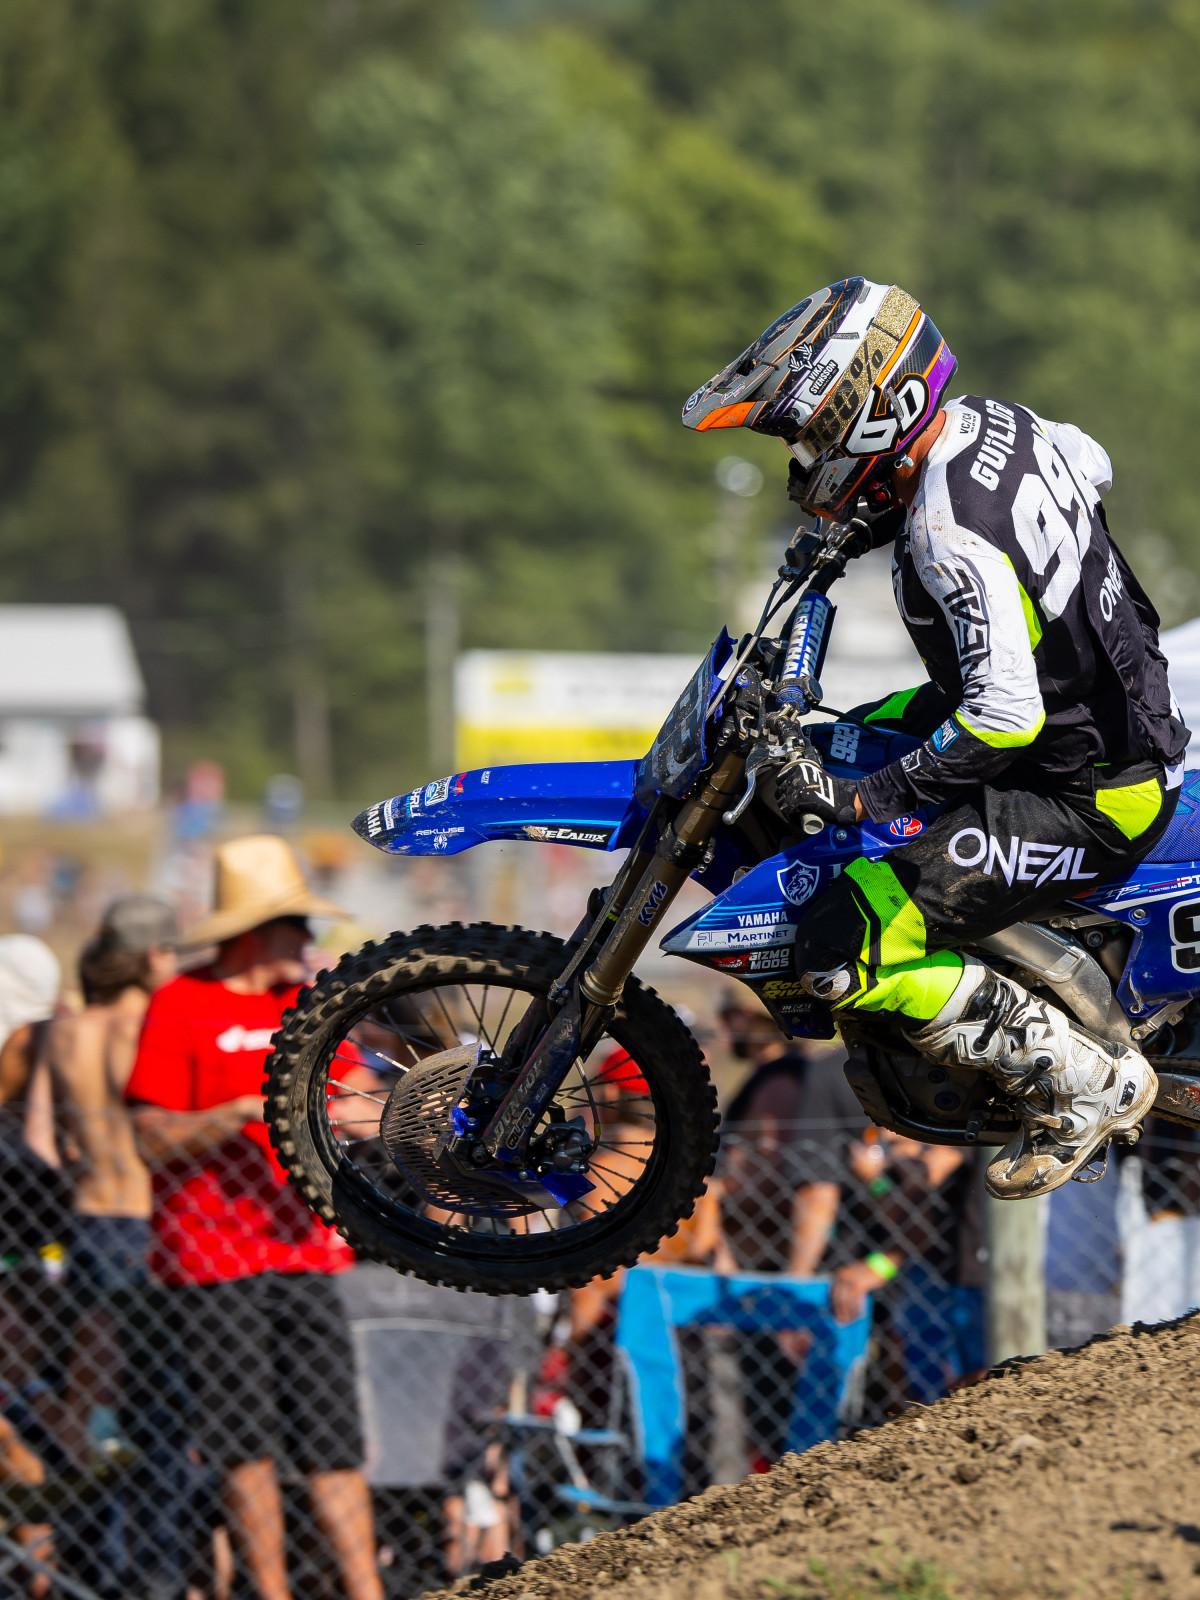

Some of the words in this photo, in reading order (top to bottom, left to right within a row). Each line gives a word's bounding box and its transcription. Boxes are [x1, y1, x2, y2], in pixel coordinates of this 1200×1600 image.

[808, 364, 825, 380] VIKA
[811, 361, 837, 394] SVENSSON
[830, 724, 860, 764] 992
[416, 826, 465, 837] REKLUSE
[638, 881, 668, 927] KYB
[737, 911, 788, 927] YAMAHA
[749, 948, 790, 961] GIZMO
[750, 958, 789, 970] MODS
[763, 980, 802, 991] ROC
[764, 988, 807, 999] RIVE
